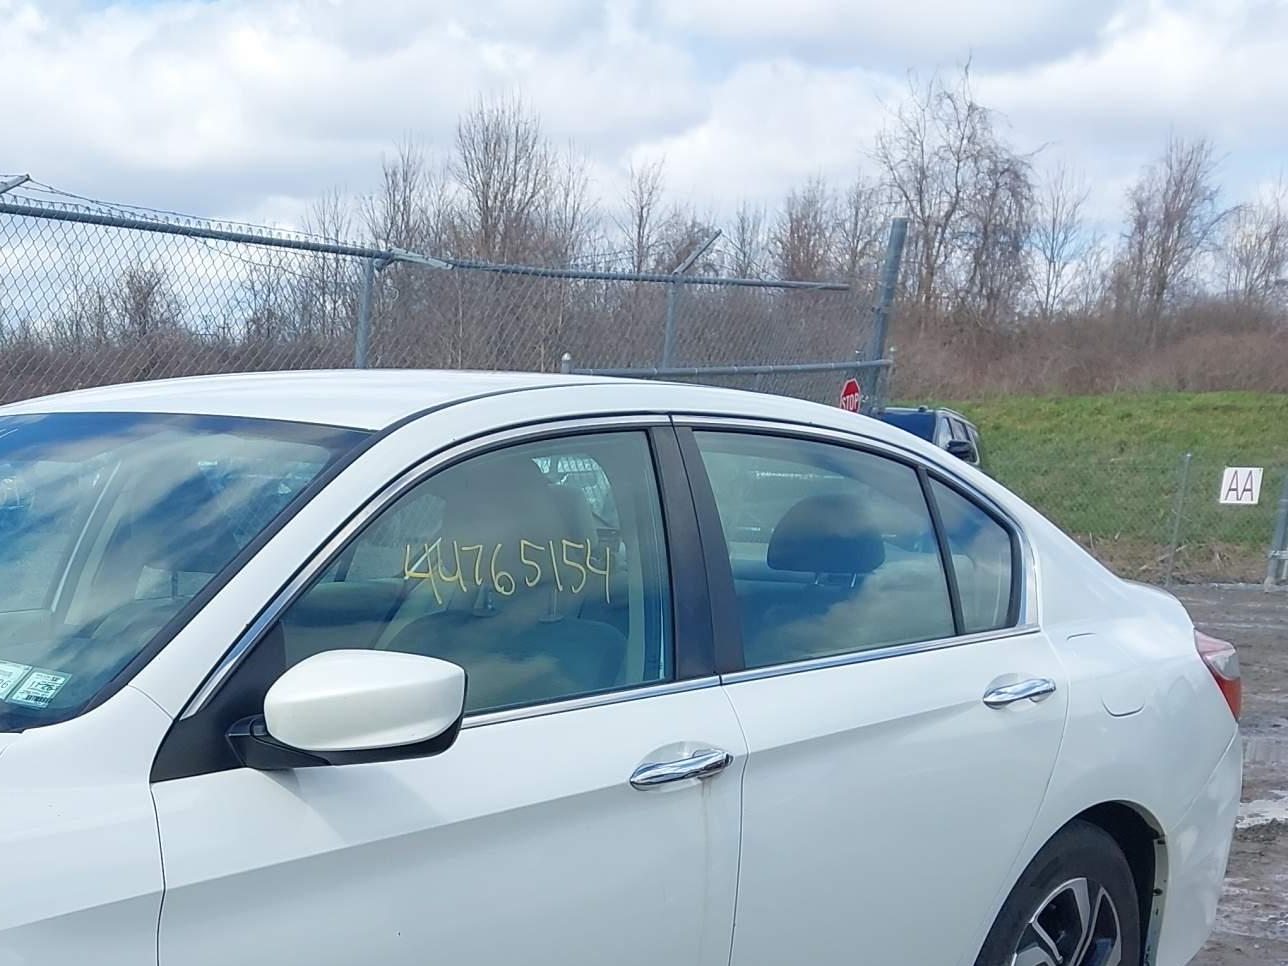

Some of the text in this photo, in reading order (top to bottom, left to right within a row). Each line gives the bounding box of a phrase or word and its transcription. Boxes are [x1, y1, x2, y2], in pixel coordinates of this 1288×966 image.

[841, 392, 859, 410] STOP
[1224, 469, 1254, 501] AA
[404, 537, 611, 604] 44765154
